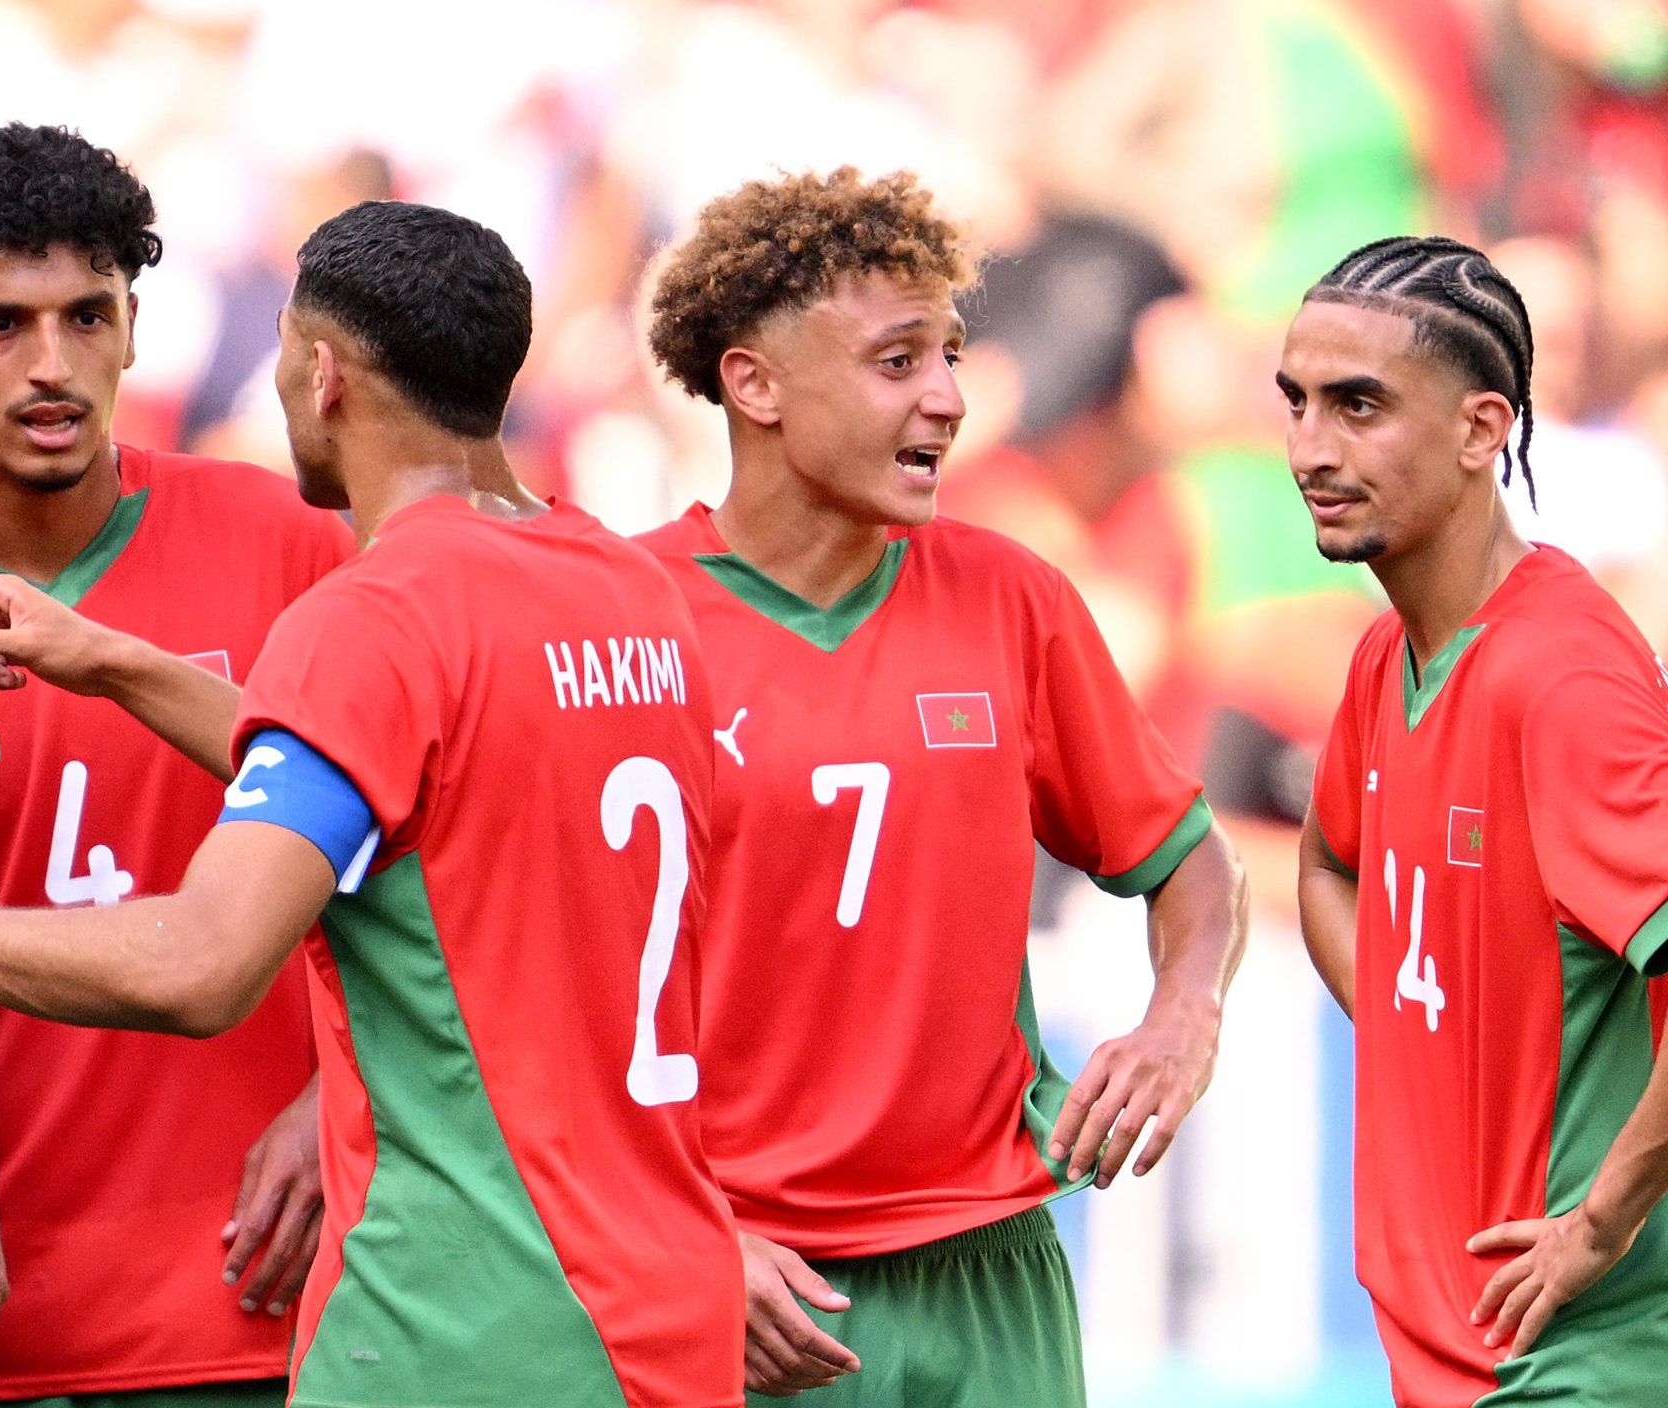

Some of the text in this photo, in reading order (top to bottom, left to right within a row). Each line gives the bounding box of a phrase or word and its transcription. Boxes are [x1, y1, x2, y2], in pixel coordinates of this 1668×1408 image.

[544, 636, 686, 709] HAKIMI
[45, 760, 133, 907] 4
[224, 745, 285, 808] C
[811, 762, 890, 928] 7
[600, 756, 698, 1107] 2
